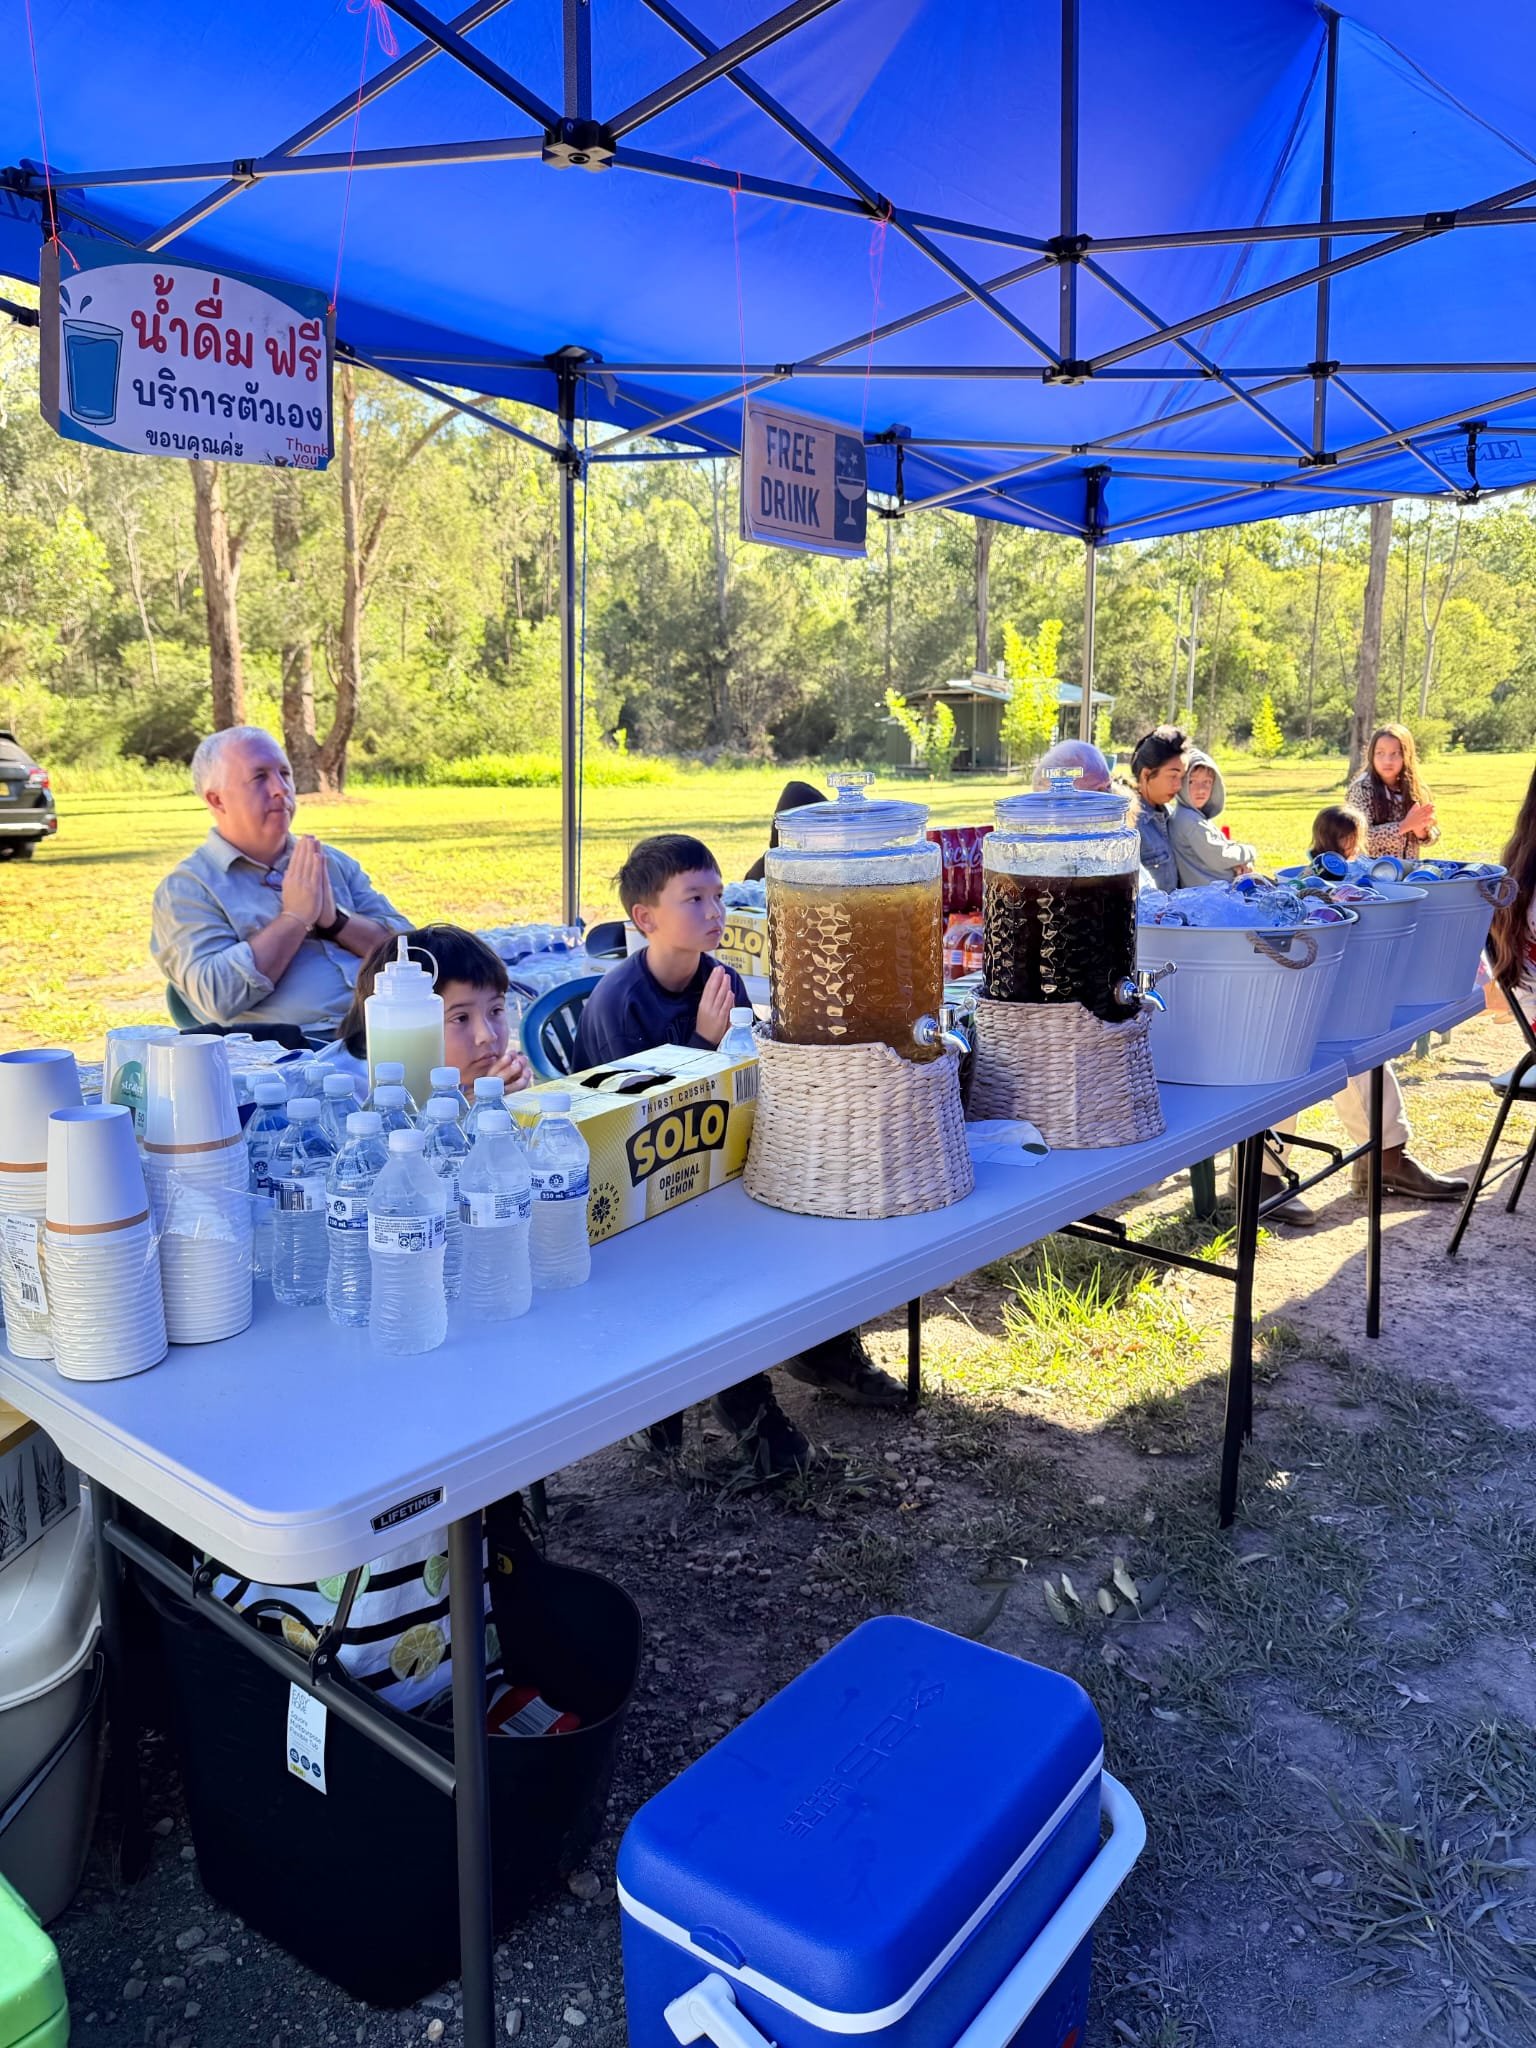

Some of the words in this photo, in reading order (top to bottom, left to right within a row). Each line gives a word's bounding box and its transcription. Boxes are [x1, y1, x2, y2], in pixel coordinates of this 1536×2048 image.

[131, 274, 253, 368] น้ำดื่ม
[265, 320, 321, 381] ฟรี
[132, 367, 322, 431] บริการตัวเอง
[145, 429, 243, 459] ขอบคุณค่ะ
[286, 437, 328, 456] Thank
[293, 454, 317, 466] you
[766, 425, 816, 475] FREE
[760, 476, 820, 528] DRINK
[720, 927, 762, 953] OLO
[642, 1096, 673, 1115] THIRST
[679, 1080, 716, 1101] CRUSHER
[633, 1103, 725, 1178] SOLO
[660, 1163, 700, 1190] ORIGINAL
[665, 1178, 694, 1201] LEMON
[380, 1493, 436, 1526] LIFETIME
